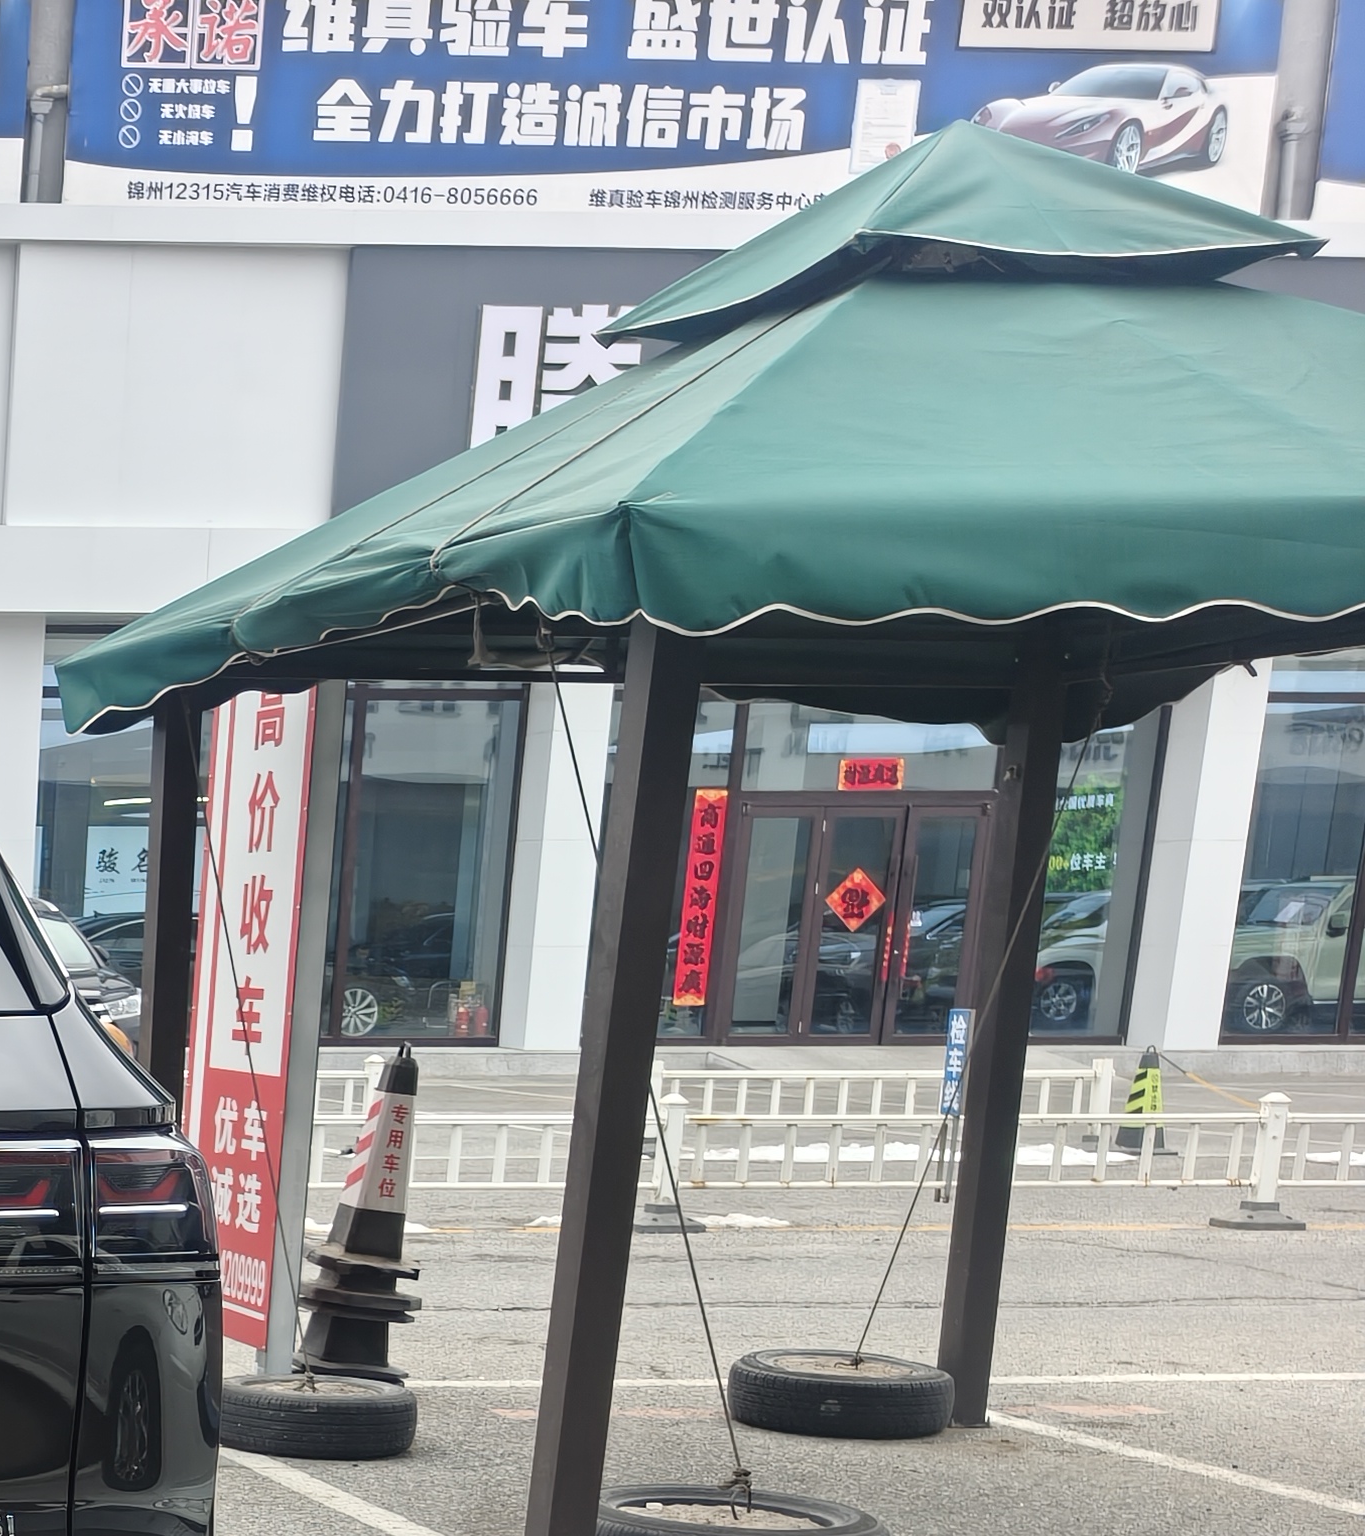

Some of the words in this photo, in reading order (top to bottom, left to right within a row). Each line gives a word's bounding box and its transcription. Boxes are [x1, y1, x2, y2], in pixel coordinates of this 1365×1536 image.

[281, 0, 589, 57] 维真验车
[627, 0, 932, 65] 盛世认证
[313, 78, 808, 151] 全力打造诚信市场
[231, 691, 287, 1057] 高价收车
[213, 1095, 268, 1162] 优车
[378, 1103, 410, 1199] 专用车位
